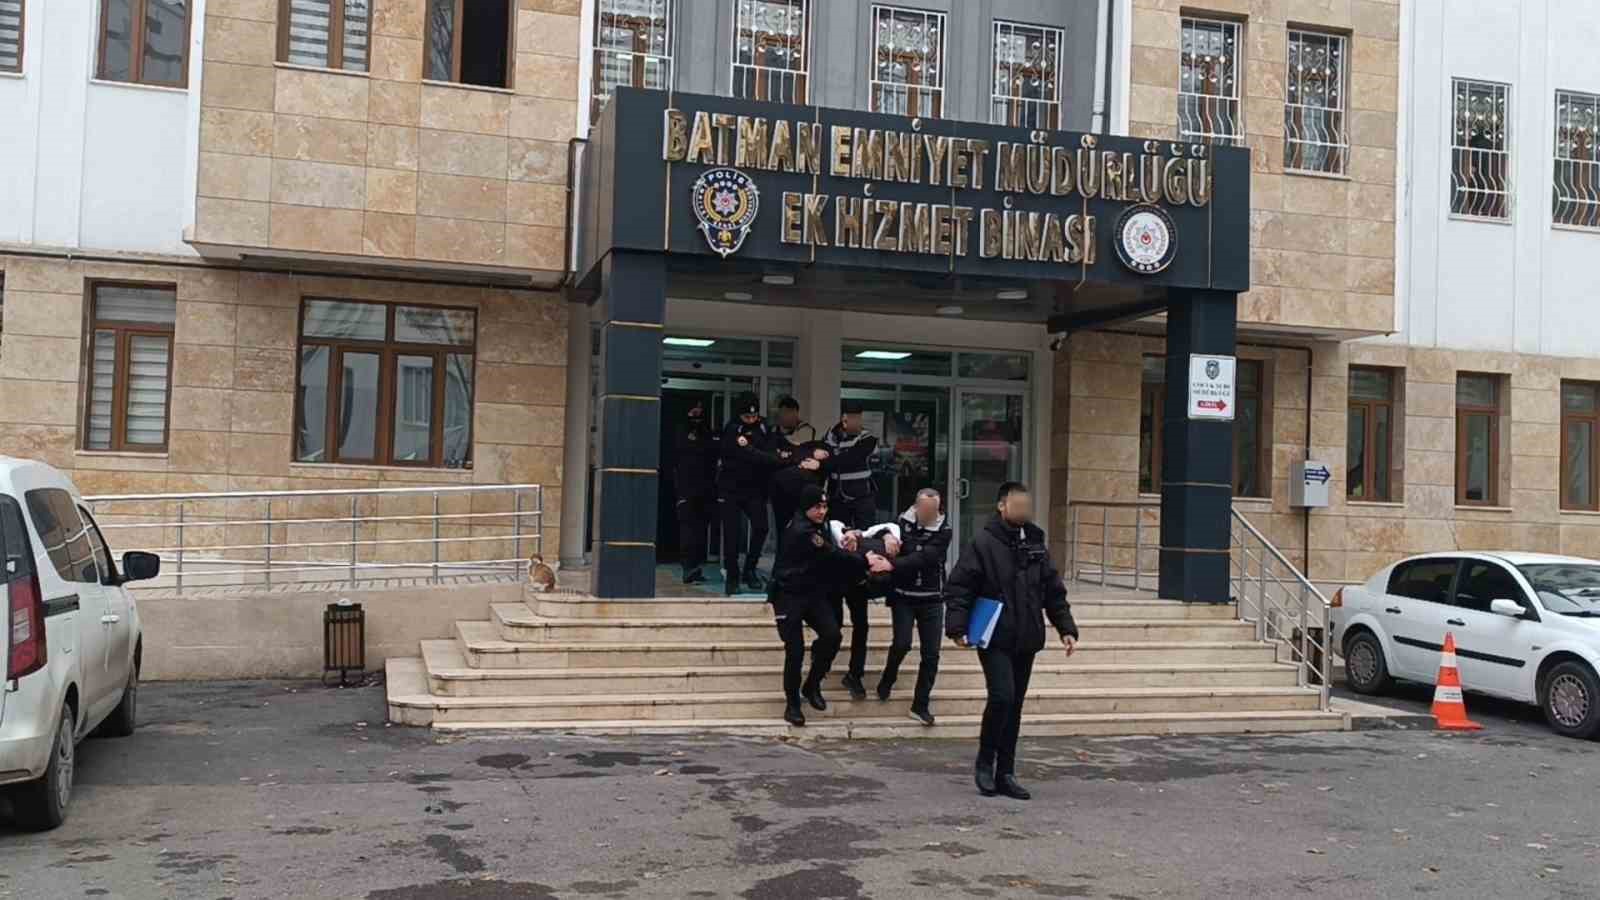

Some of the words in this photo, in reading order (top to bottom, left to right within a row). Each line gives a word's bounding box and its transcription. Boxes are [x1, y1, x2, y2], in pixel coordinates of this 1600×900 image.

[663, 108, 823, 175] BATMAN
[829, 117, 989, 190] EMNİYET
[994, 130, 1213, 207] MÜDÜRLÜĞÜ
[780, 191, 829, 246] EK
[834, 183, 973, 257] HİZMET
[979, 196, 1097, 265] BİNASI
